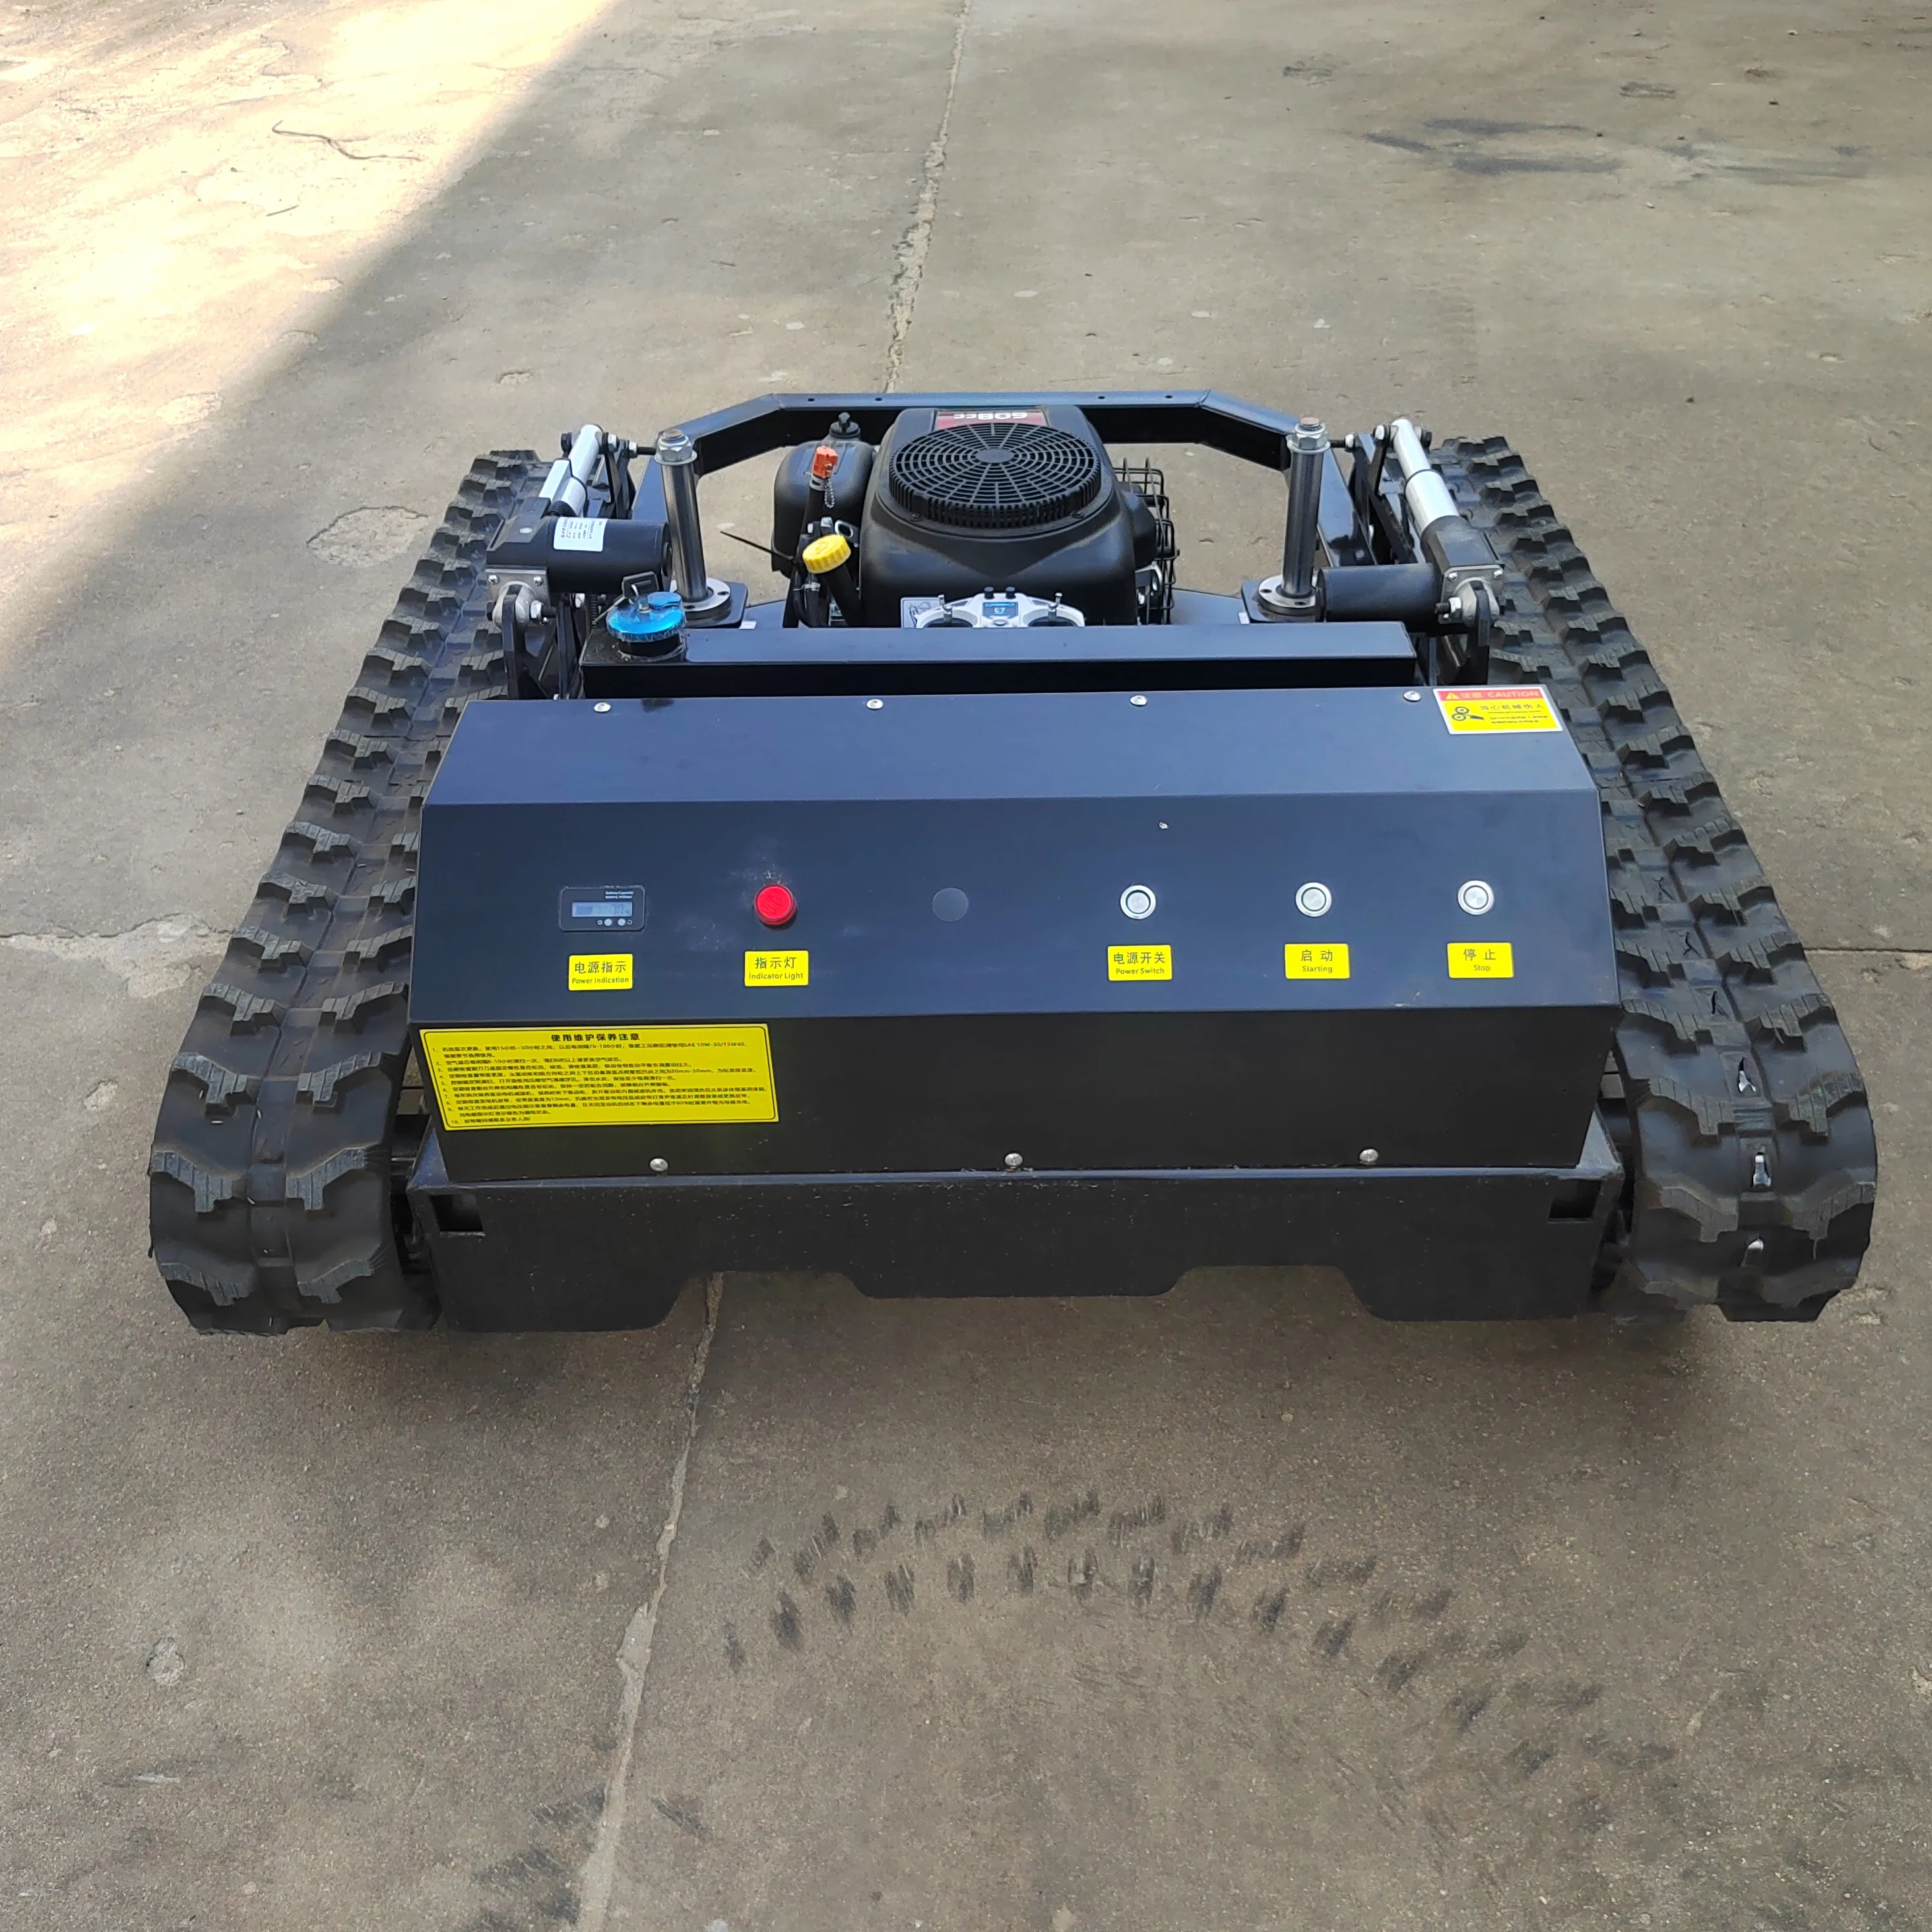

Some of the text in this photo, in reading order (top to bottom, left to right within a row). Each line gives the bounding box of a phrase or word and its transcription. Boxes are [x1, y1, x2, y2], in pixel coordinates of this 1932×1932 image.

[1114, 951, 1165, 964] 电源开关
[1301, 950, 1333, 961] 启动
[1463, 949, 1497, 961] 停止
[575, 961, 626, 974] 电源指示
[755, 956, 797, 969] 指示灯
[785, 972, 804, 981] Light
[551, 1033, 640, 1042] 使用维护保养注意
